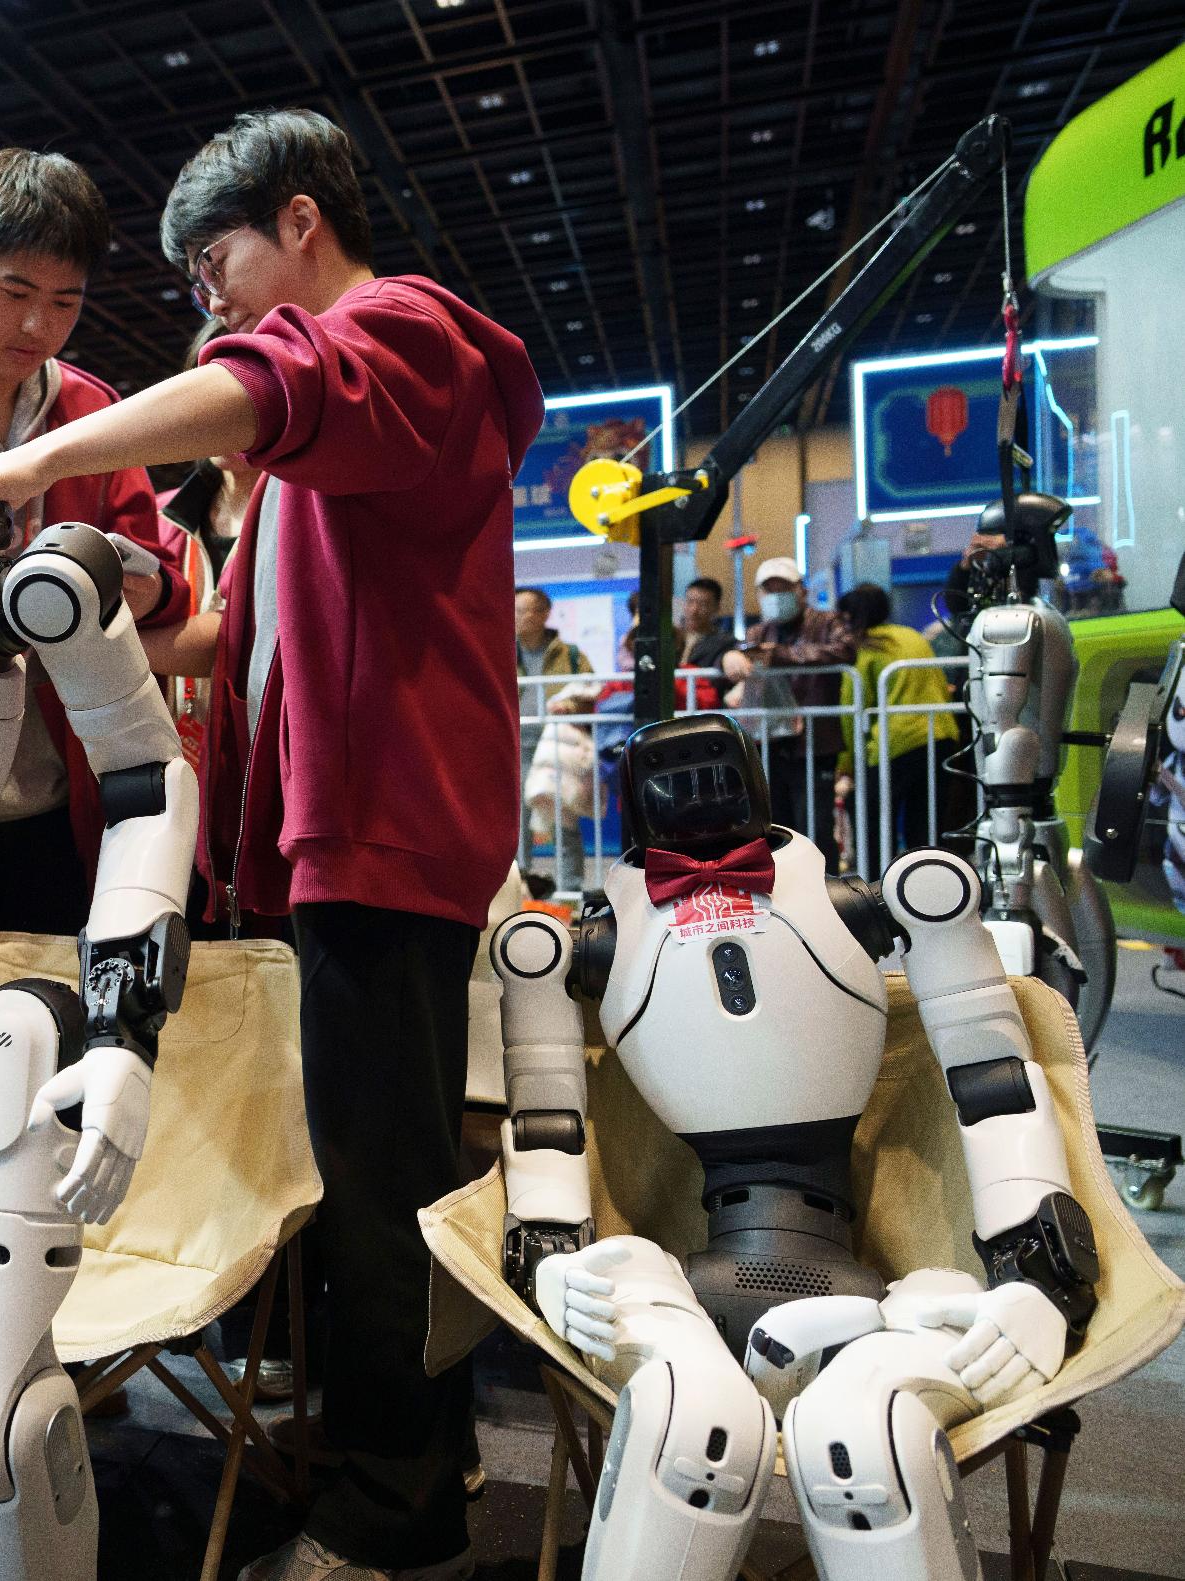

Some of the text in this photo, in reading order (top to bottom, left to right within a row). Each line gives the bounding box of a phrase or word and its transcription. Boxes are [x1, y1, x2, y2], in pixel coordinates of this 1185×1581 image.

[679, 918, 756, 939] 城市之间科技
